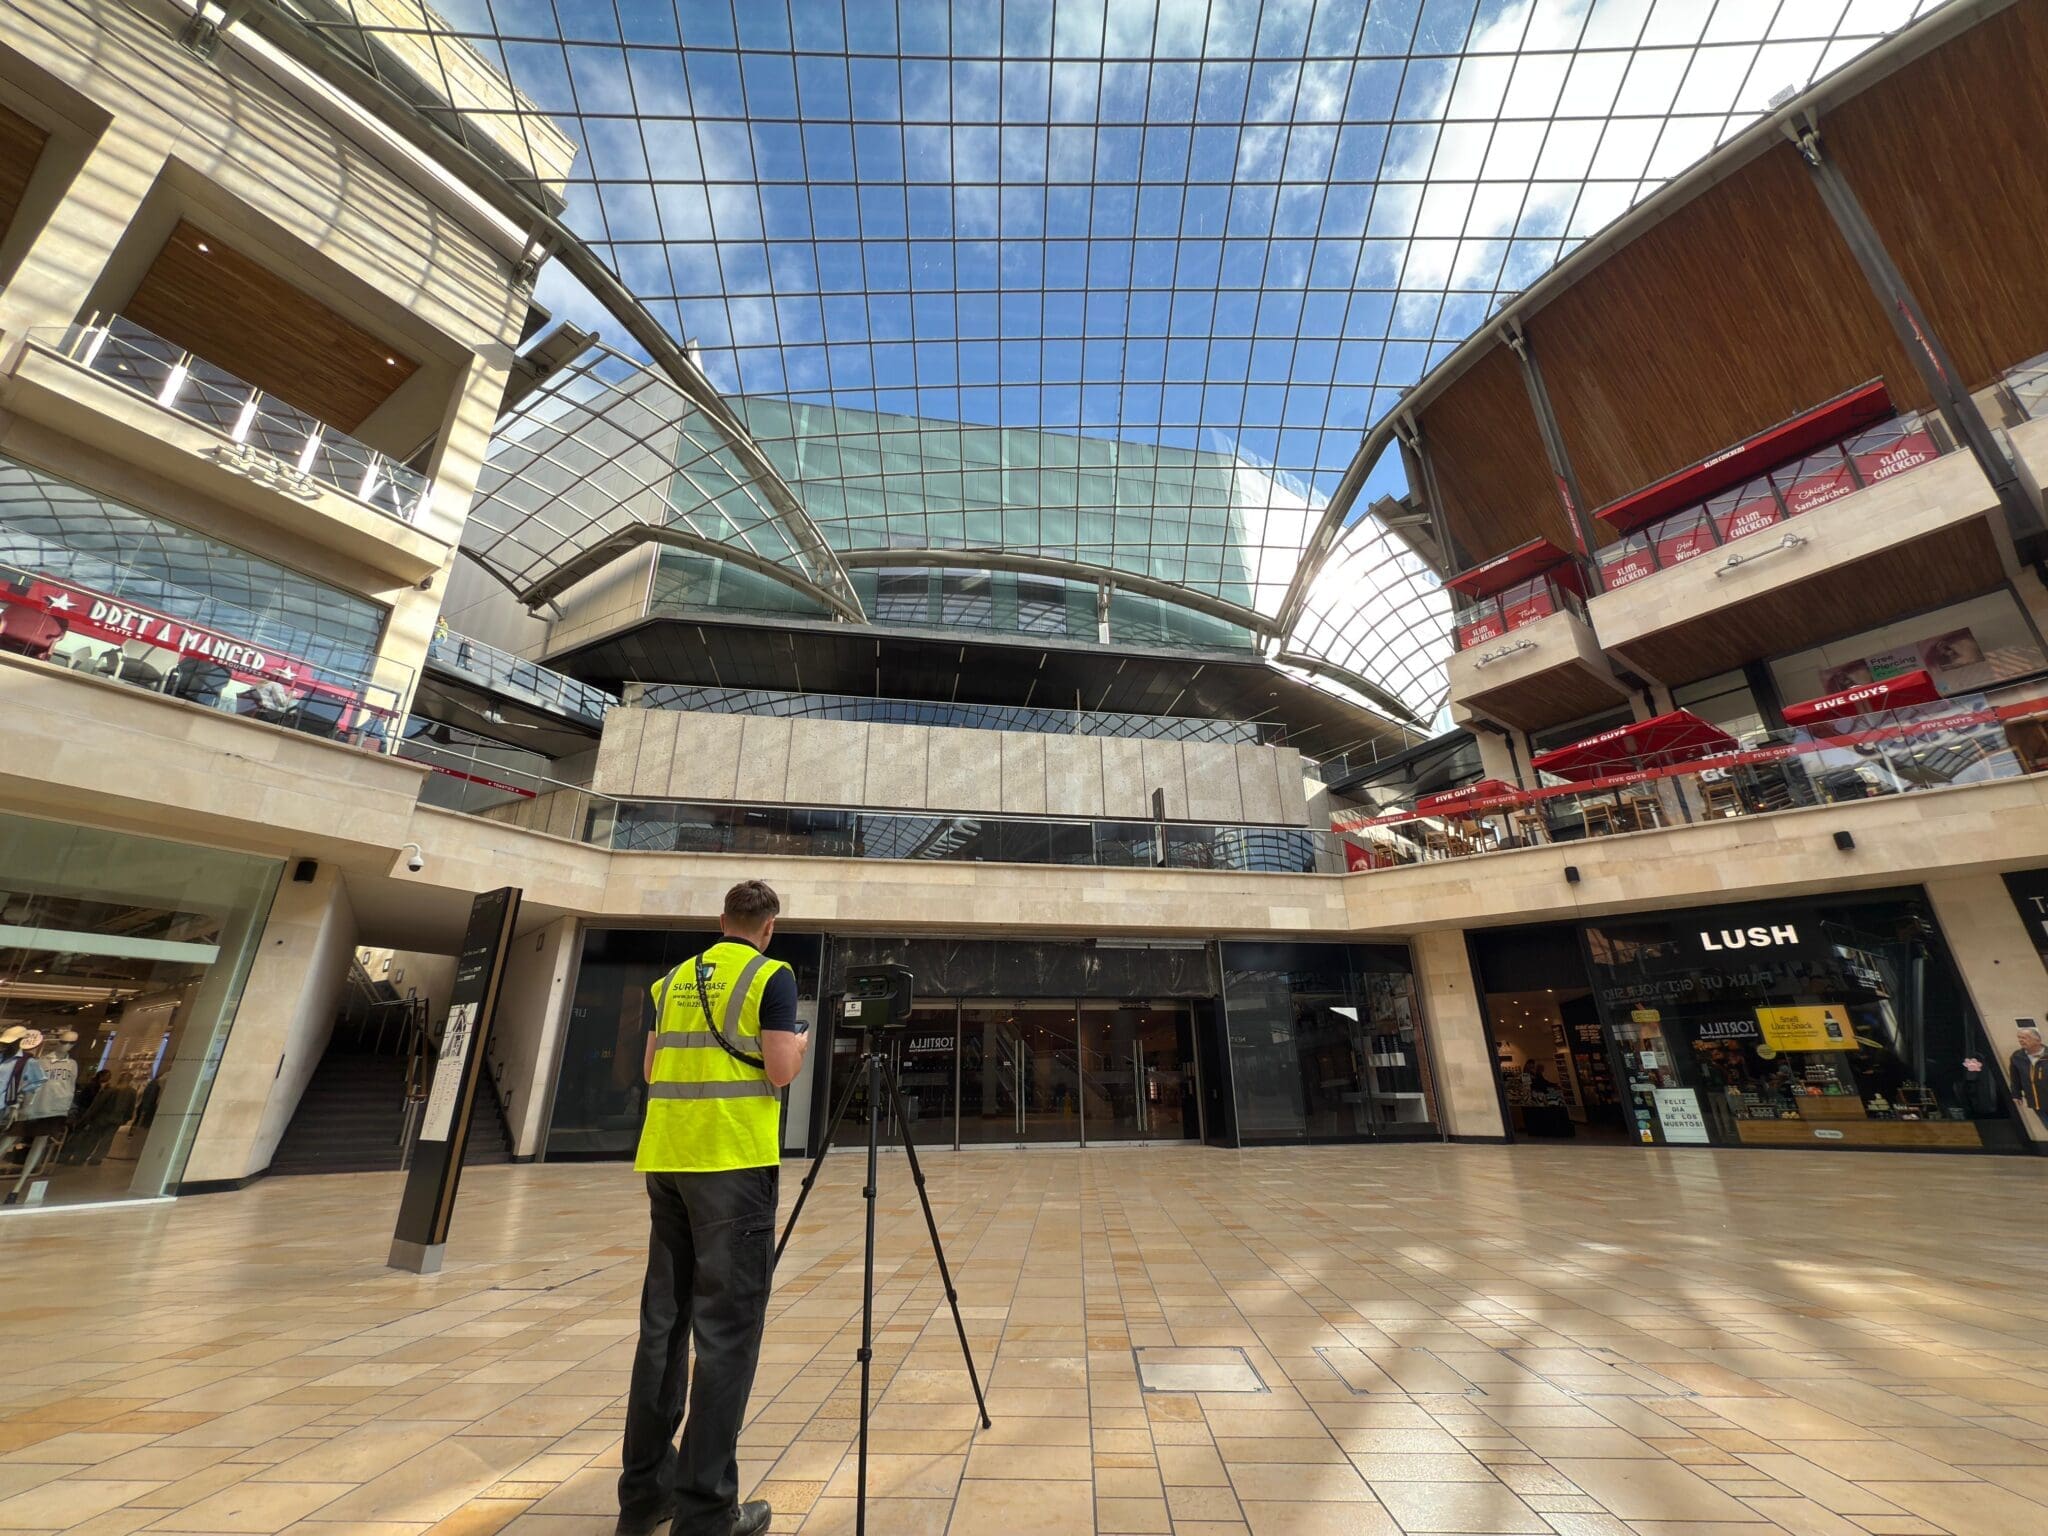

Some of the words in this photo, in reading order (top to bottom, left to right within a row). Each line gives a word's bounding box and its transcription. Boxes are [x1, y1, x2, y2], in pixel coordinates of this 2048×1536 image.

[1873, 452, 1926, 480] CHICKENS
[1880, 448, 1910, 467] SLIM
[1794, 485, 1850, 513] Sandwiches
[1730, 515, 1773, 538] CHICKENS
[1736, 511, 1760, 527] SLIM
[1675, 547, 1701, 561] Wings
[1612, 566, 1648, 587] CHICKENS
[1616, 562, 1637, 576] SLIM
[103, 624, 133, 637] LATTE
[1468, 629, 1496, 646] CHICKENS
[1472, 625, 1488, 637] SLIM
[1814, 696, 1847, 711] FIVE
[1848, 685, 1889, 701] GUYS
[1921, 720, 1943, 730] FIVE
[1945, 716, 1974, 726] GUYS
[1578, 738, 1599, 748] FIVE
[1600, 729, 1627, 741] GUYS
[1753, 750, 1772, 758] FIVE
[1773, 746, 1797, 755] GUYS
[1435, 793, 1453, 803] FIVE
[1455, 786, 1477, 798] GUYS
[1700, 924, 1800, 951] LUSH
